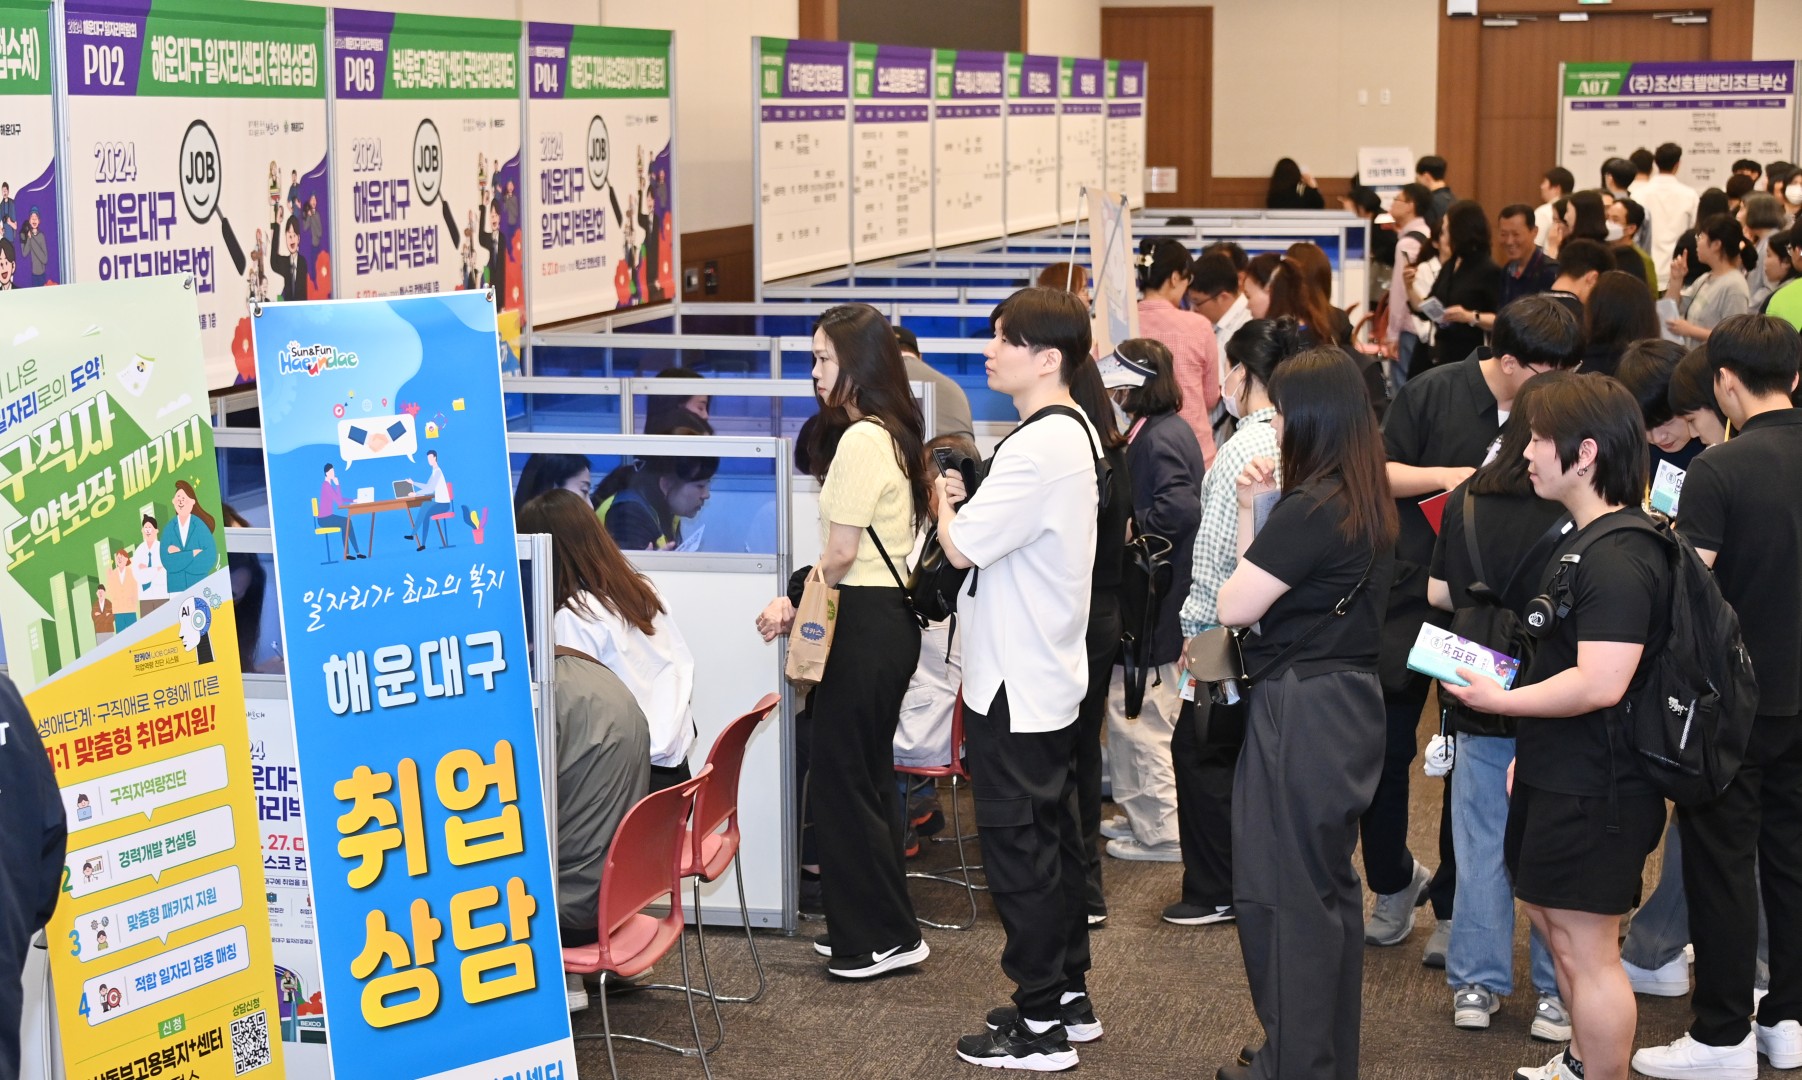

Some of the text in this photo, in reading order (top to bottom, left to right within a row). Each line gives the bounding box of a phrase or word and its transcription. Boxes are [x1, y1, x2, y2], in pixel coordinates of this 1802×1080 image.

[83, 44, 125, 86] P02
[151, 35, 318, 87] 해운대구 일자리센터(취업상담)
[344, 57, 375, 92] P03
[534, 63, 559, 92] P04
[1577, 80, 1610, 95] A07
[94, 142, 137, 182] 2024
[353, 138, 383, 172] 2024
[417, 146, 439, 173] JOB
[540, 132, 564, 161] 2024
[590, 139, 606, 162] JOB
[185, 151, 215, 184] JOB
[541, 167, 584, 205] 해운대구
[96, 191, 177, 244] 해운대구
[353, 179, 411, 224] 해운대구
[542, 207, 606, 250] 일자리박람회
[355, 225, 439, 276] 일자리박람회
[291, 345, 332, 357] Sun&Fun
[7, 359, 38, 393] 나은
[70, 354, 106, 393] 도약!
[3, 414, 203, 572] 도약보장 패키지
[181, 605, 190, 616] AI
[303, 584, 394, 632] 일자리가
[402, 573, 462, 604] 최고의
[322, 630, 507, 716] 해운대구
[152, 683, 192, 711] 유형에
[194, 675, 220, 699] 따른
[74, 727, 132, 767] 맞춤형
[136, 705, 216, 748] 취업지원!
[109, 769, 188, 805] 구직자역량진단
[333, 739, 523, 889] 취업
[118, 829, 197, 869] 경력개발 컨설팅
[262, 855, 290, 870] 스코
[61, 865, 74, 893] 2
[126, 887, 218, 932] 맞춤형 패키지 지원
[68, 929, 82, 957] 3
[350, 876, 536, 1028] 상담
[134, 943, 238, 993] 적합 일자리 집중 매칭
[78, 992, 90, 1018] 4
[232, 997, 261, 1017] 상담신청
